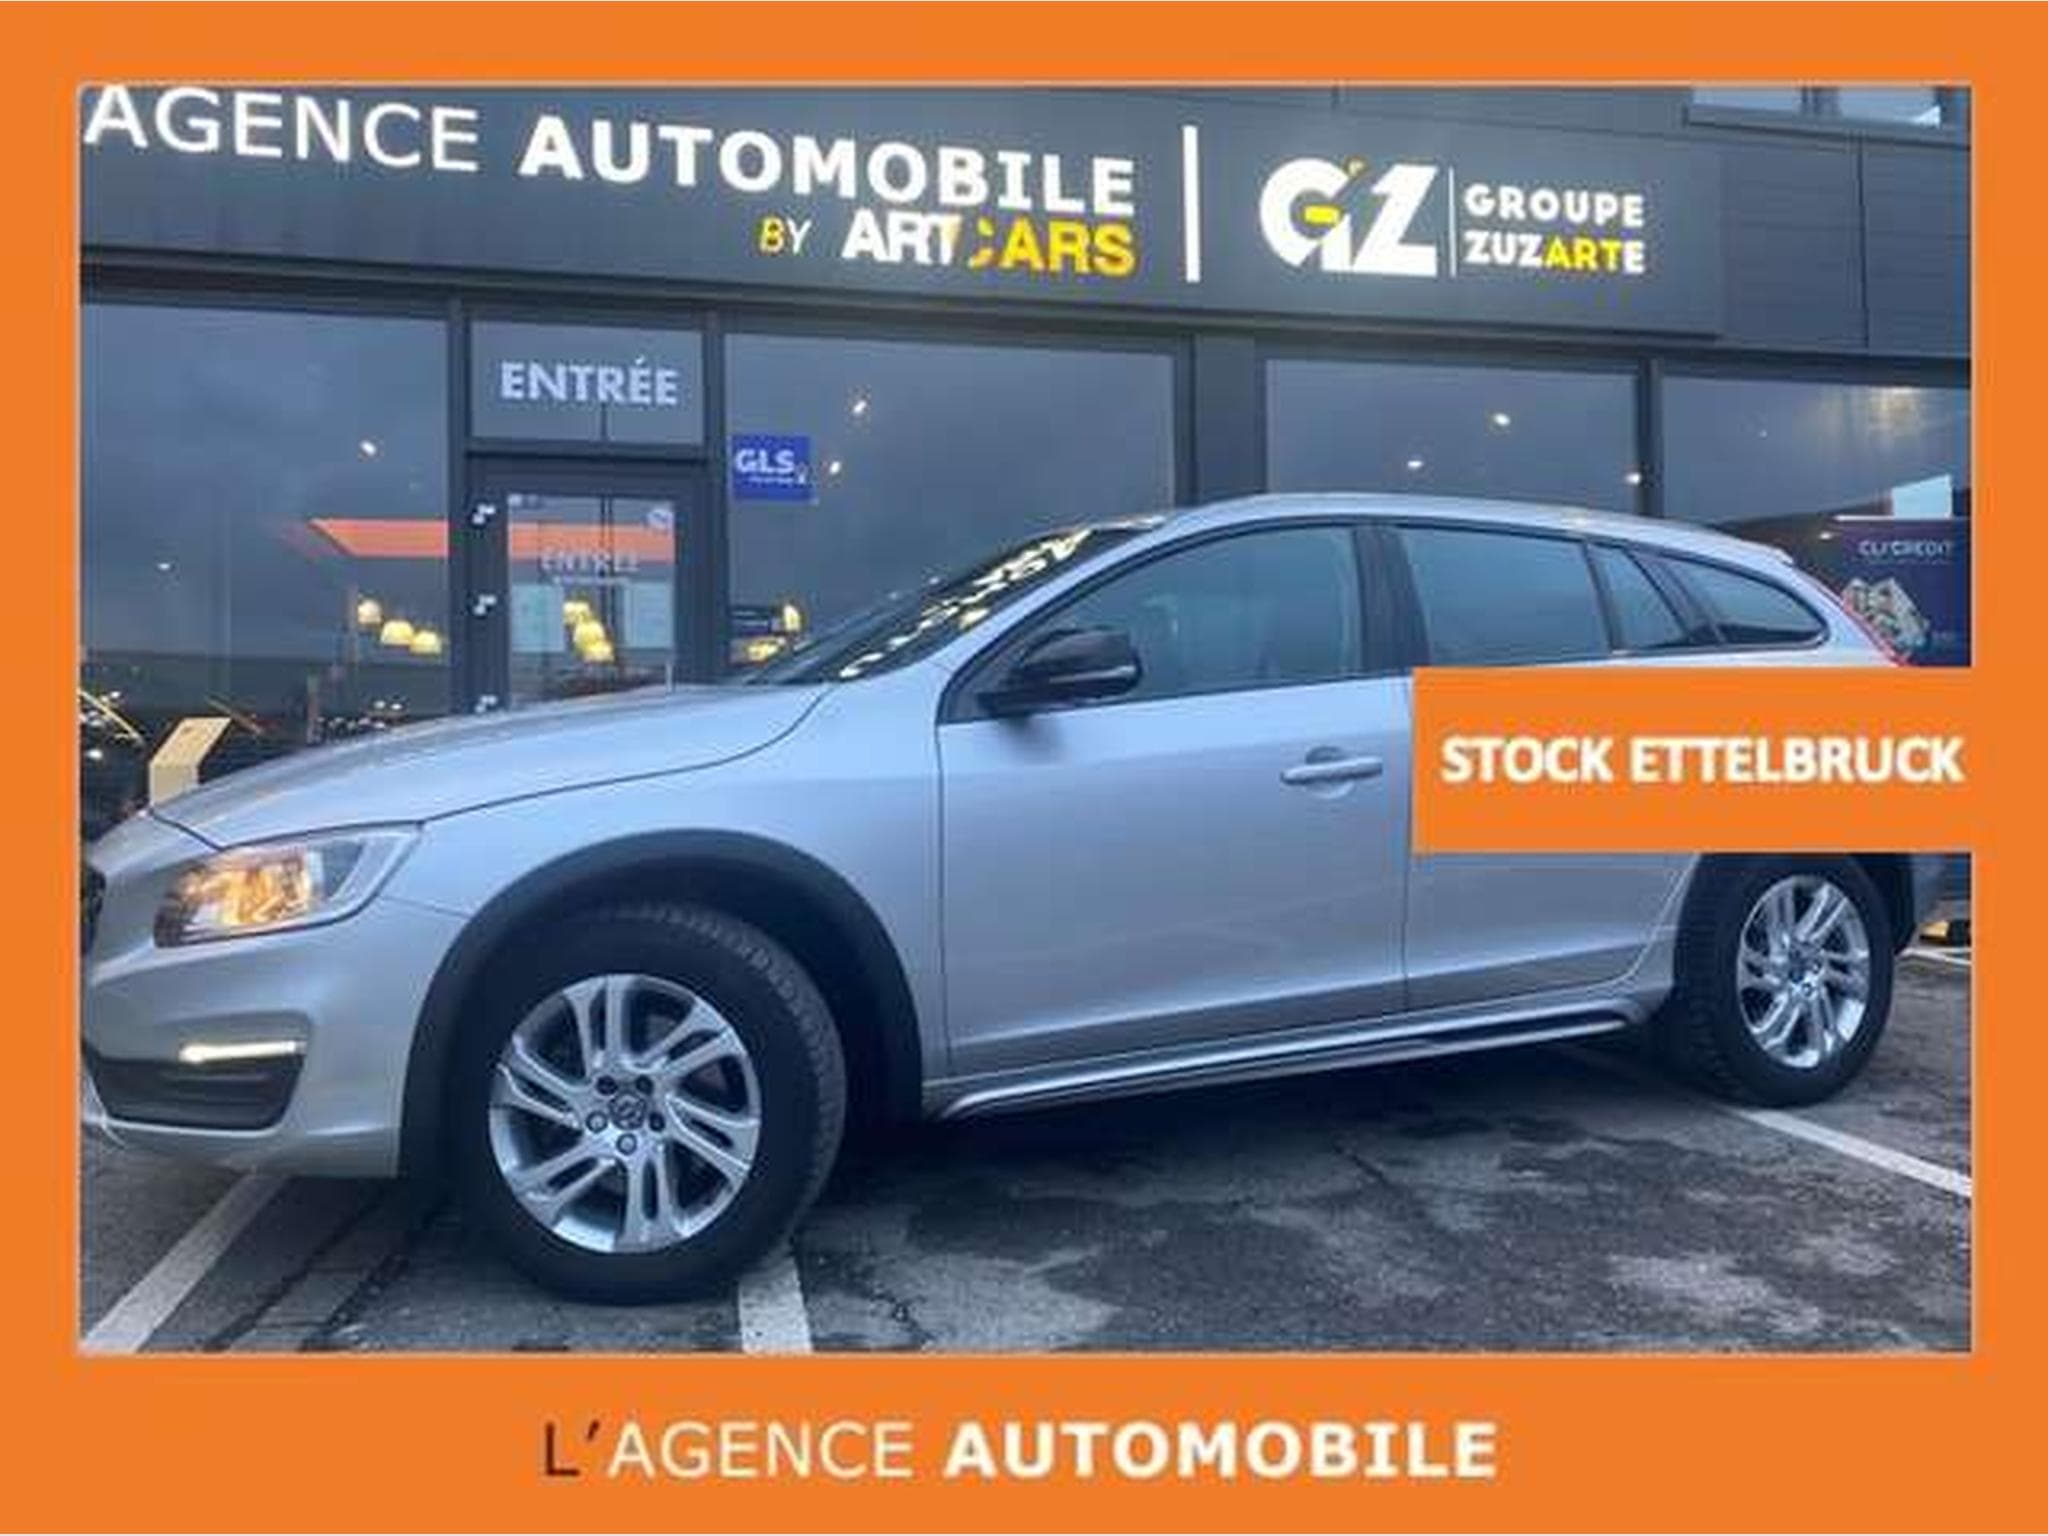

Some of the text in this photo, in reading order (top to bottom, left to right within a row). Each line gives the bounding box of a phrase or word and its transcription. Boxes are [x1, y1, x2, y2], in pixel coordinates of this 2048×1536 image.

[84, 85, 1134, 216] AGENCE AUTOMOBILE
[1464, 183, 1643, 227] GROUPE
[760, 216, 811, 254] BY
[1464, 231, 1645, 275] ZUZARTE
[501, 356, 678, 405] ENTRÉE
[735, 449, 795, 473] GLS
